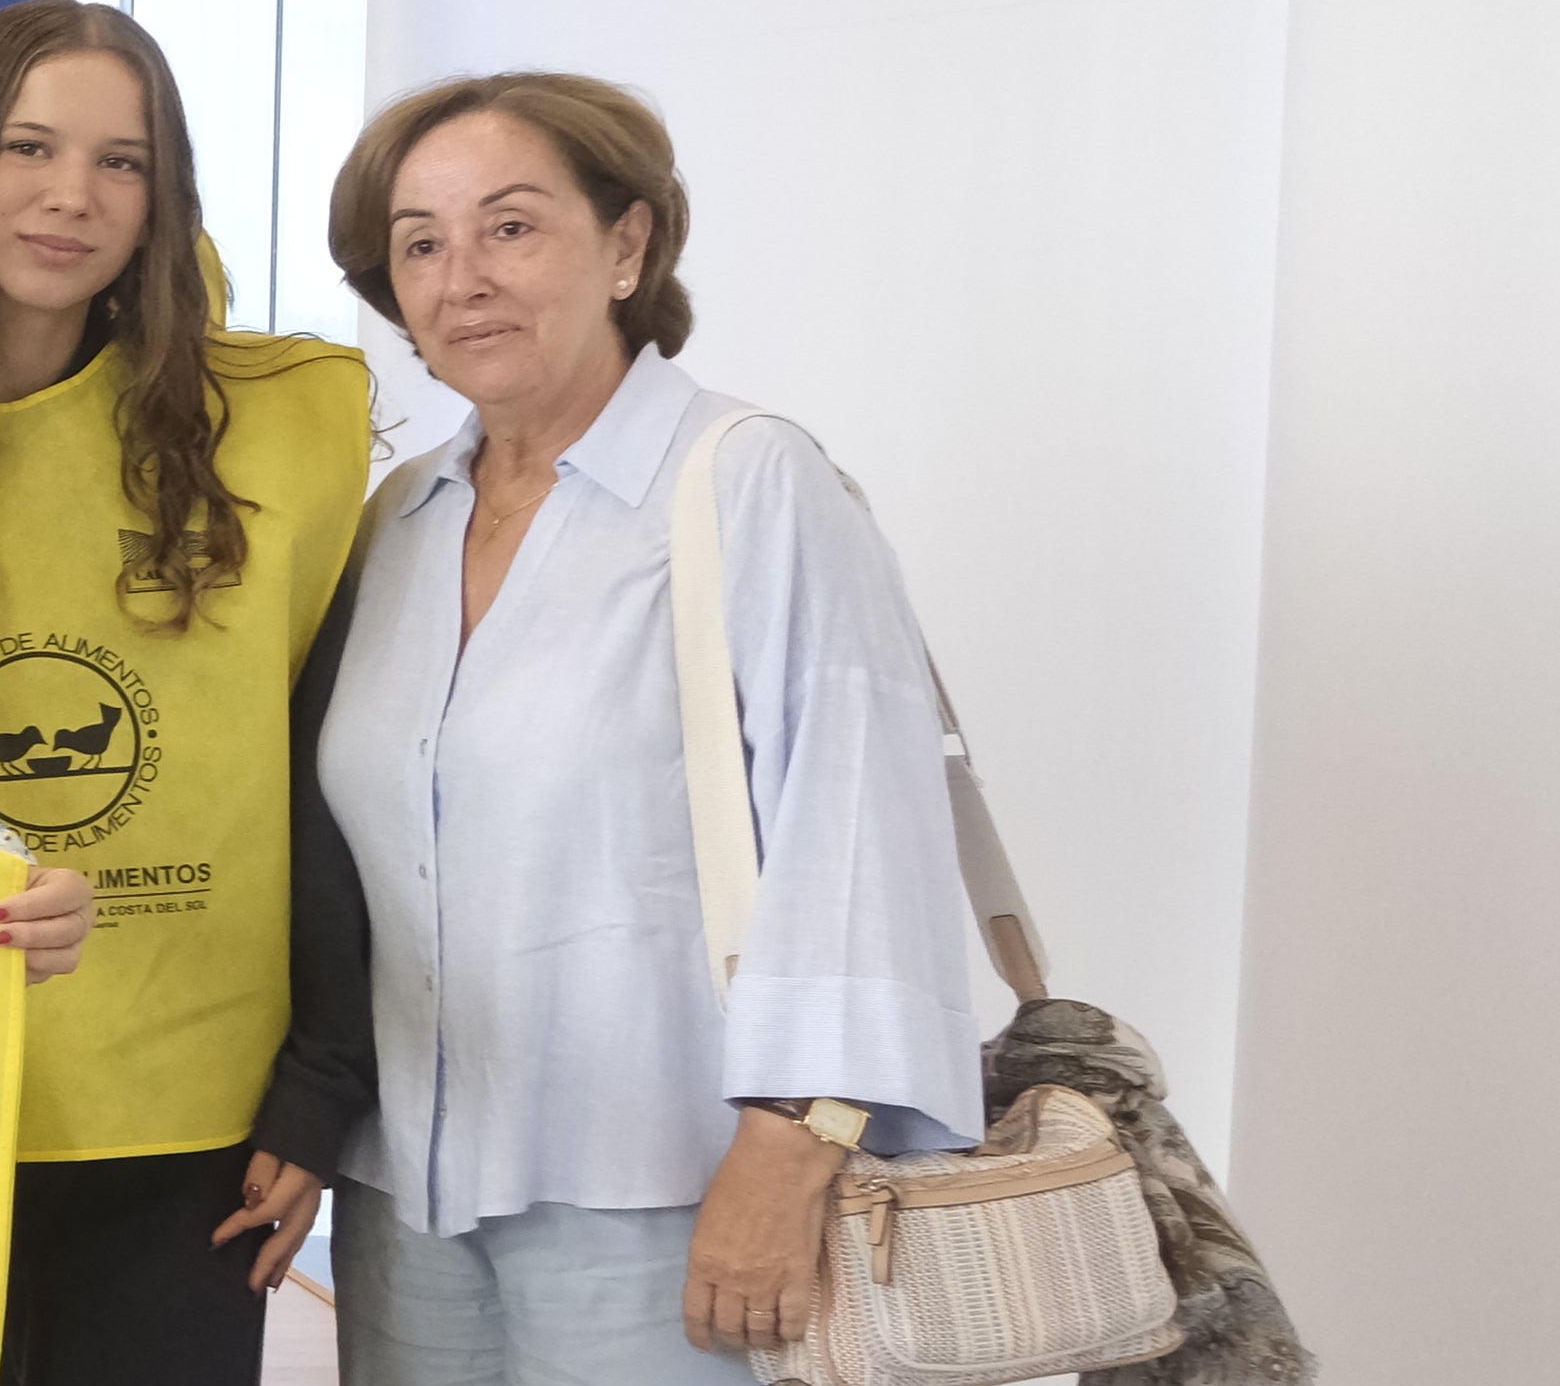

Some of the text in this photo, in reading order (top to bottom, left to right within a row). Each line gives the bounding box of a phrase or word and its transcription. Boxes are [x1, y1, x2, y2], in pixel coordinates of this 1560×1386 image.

[43, 632, 160, 726] ALIMENTOS
[24, 832, 59, 853] DE
[63, 745, 162, 852] ALIMENTOS
[93, 863, 212, 889] IMENTOS
[108, 904, 153, 917] COSTA
[156, 902, 183, 913] DEL
[185, 900, 207, 910] SOL
